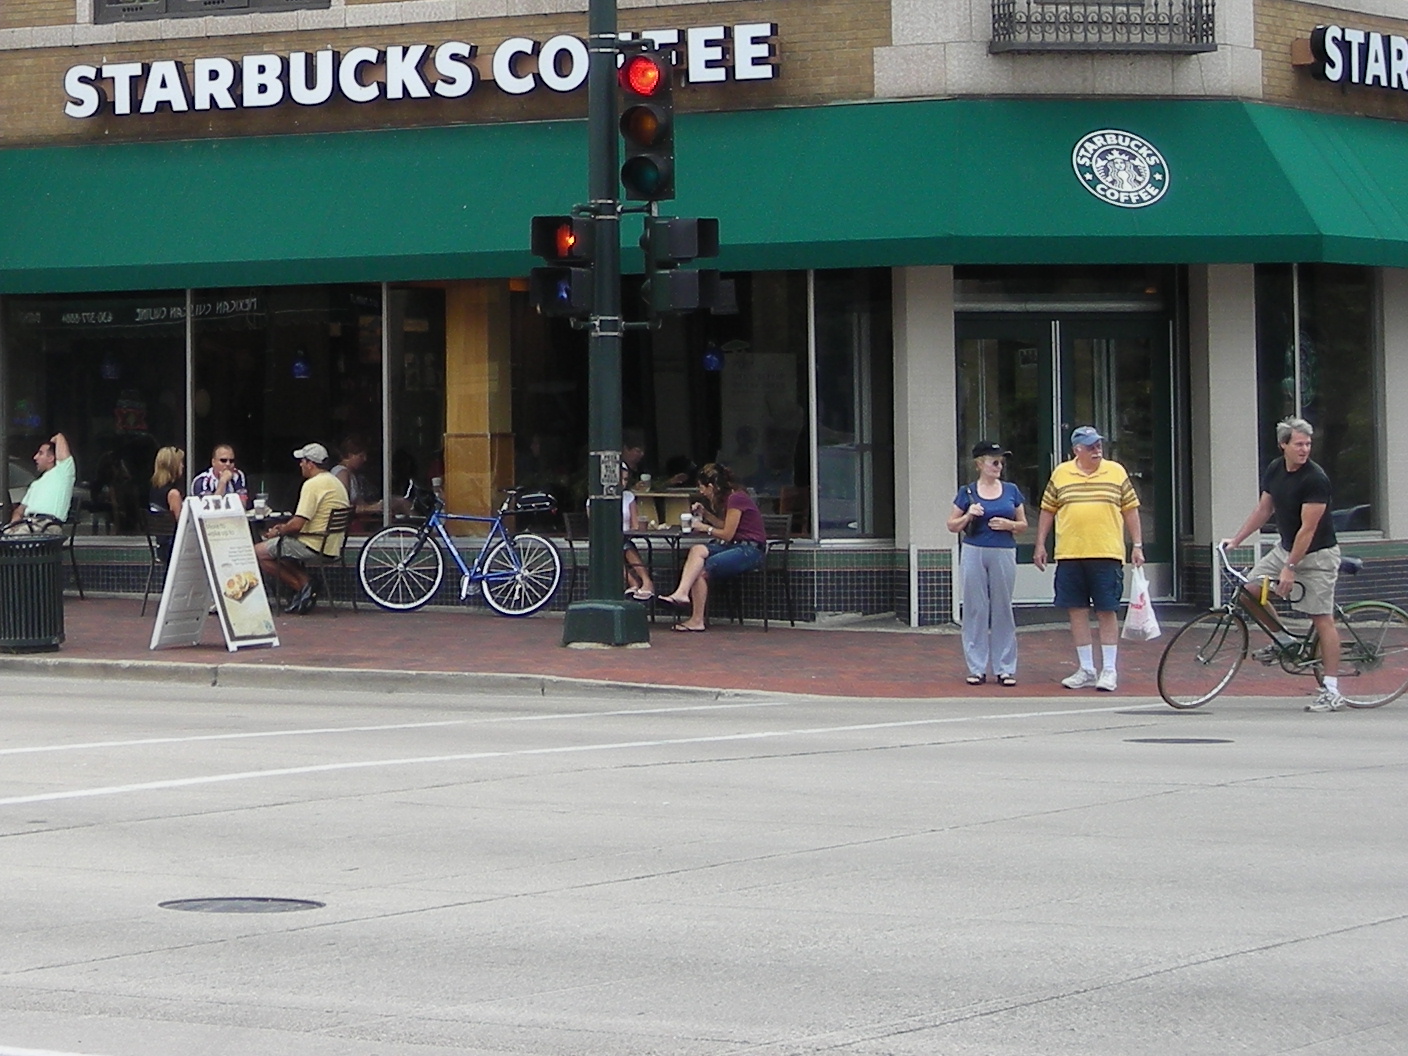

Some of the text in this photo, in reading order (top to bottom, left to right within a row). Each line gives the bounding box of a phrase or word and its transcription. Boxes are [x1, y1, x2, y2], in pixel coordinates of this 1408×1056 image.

[63, 40, 476, 119] STARBUCKS
[493, 22, 774, 95] COEE
[1325, 25, 1408, 91] STAR
[1076, 133, 1160, 166] STARBUCKS
[1095, 183, 1160, 204] COFFEE
